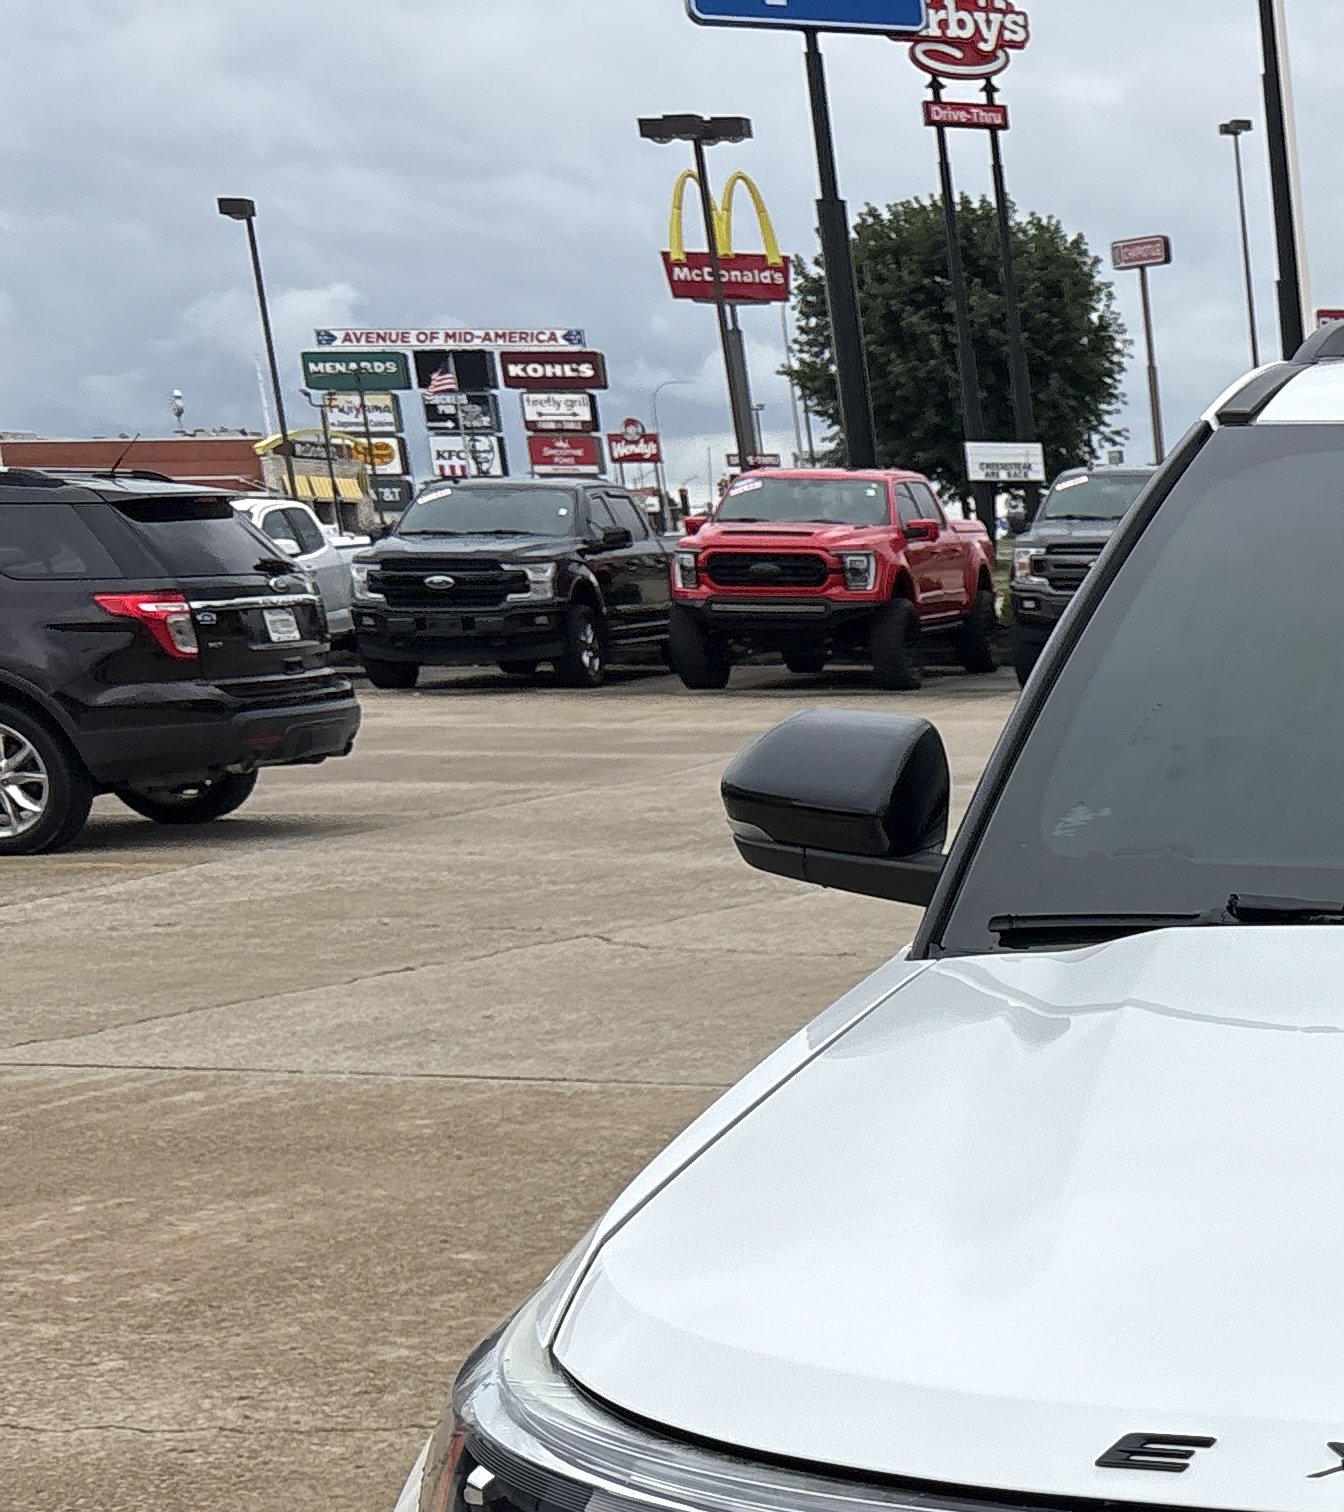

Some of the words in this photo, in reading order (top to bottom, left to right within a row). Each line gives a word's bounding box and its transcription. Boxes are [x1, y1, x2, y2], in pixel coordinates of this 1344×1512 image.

[930, 105, 1003, 125] Drive-Thru
[671, 266, 785, 285] McDonald's
[341, 331, 411, 344] AVENUE
[415, 331, 438, 344] OF
[443, 331, 559, 344] MID-AMERICA
[307, 361, 398, 374] MENARDS
[507, 363, 595, 377] KOHL'S
[435, 449, 467, 461] KFC
